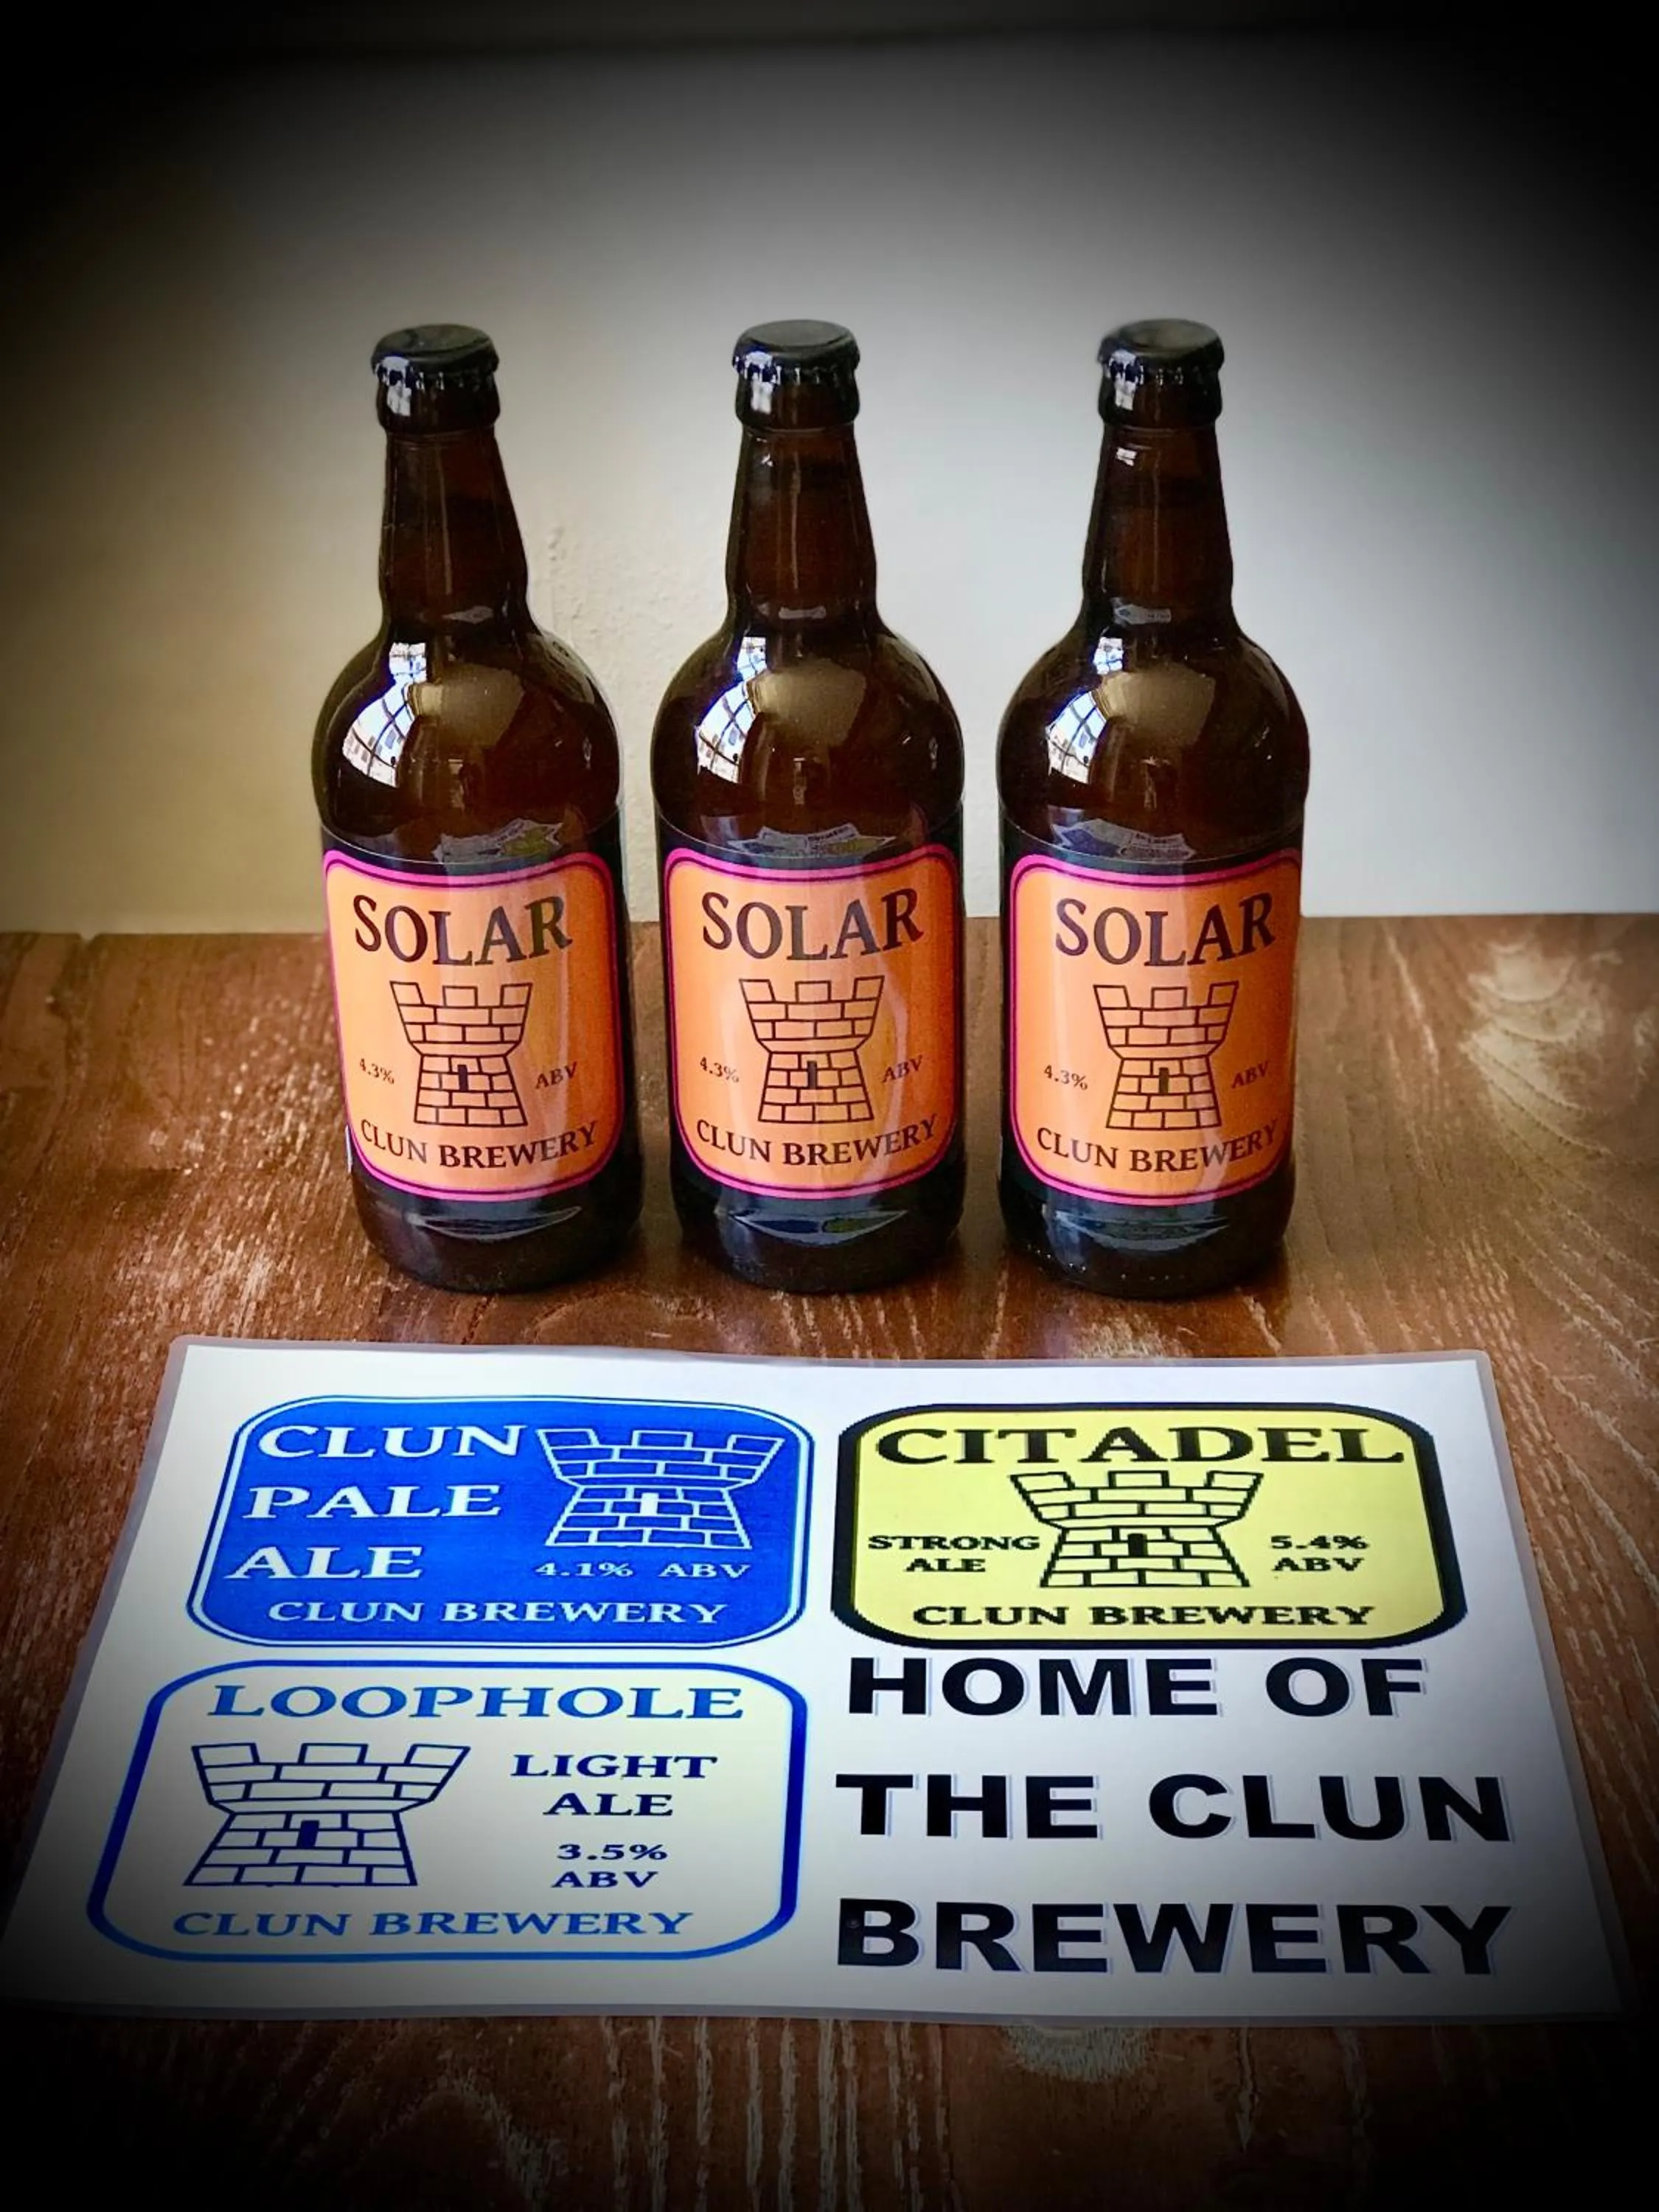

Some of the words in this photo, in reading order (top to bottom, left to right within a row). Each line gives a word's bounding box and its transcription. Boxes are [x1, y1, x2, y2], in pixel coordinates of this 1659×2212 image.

[353, 894, 573, 966] SOLAR
[701, 888, 924, 961] SOLAR
[1055, 891, 1277, 967] SOLAR
[359, 1058, 394, 1085] 4.3%
[535, 1062, 578, 1089] ABV
[699, 1057, 739, 1083] 4.3%
[883, 1055, 923, 1083] ABV
[1044, 1065, 1088, 1091] 4.3%
[1231, 1062, 1270, 1088] ABV
[361, 1119, 428, 1164] CLUN
[439, 1121, 597, 1169] BREWERY
[697, 1120, 771, 1162] CLUN
[783, 1114, 938, 1166] BREWERY
[1037, 1127, 1117, 1169] CLUN
[1130, 1119, 1279, 1172] BREWERY
[257, 1425, 527, 1458] CLUN
[876, 1427, 1405, 1465] CITADEL
[243, 1485, 501, 1518] PALE
[869, 1535, 1040, 1551] STRONG
[1270, 1535, 1368, 1550] 5.4%
[223, 1546, 423, 1579] ALE
[535, 1562, 633, 1578] 4.1%
[658, 1562, 751, 1579] ABV
[905, 1558, 986, 1573] ALE
[1272, 1557, 1365, 1573] ABV
[268, 1601, 424, 1623] CLUN
[442, 1601, 728, 1624] BREWERY
[913, 1606, 1068, 1626] CLUN
[1092, 1606, 1375, 1626] BREWERY
[848, 1657, 1220, 1717] HOME
[1265, 1657, 1425, 1717] OF
[208, 1684, 743, 1719] LOOPHOLE
[512, 1754, 717, 1778] LIGHT
[543, 1793, 673, 1816] ALE
[835, 1773, 1101, 1840] THE
[1148, 1773, 1512, 1842] CLUN
[557, 1844, 667, 1861] 3.5%
[552, 1871, 659, 1888] ABV
[173, 1913, 352, 1936] CLUN
[369, 1912, 694, 1935] BREWERY
[838, 1897, 1512, 1975] BREWERY
